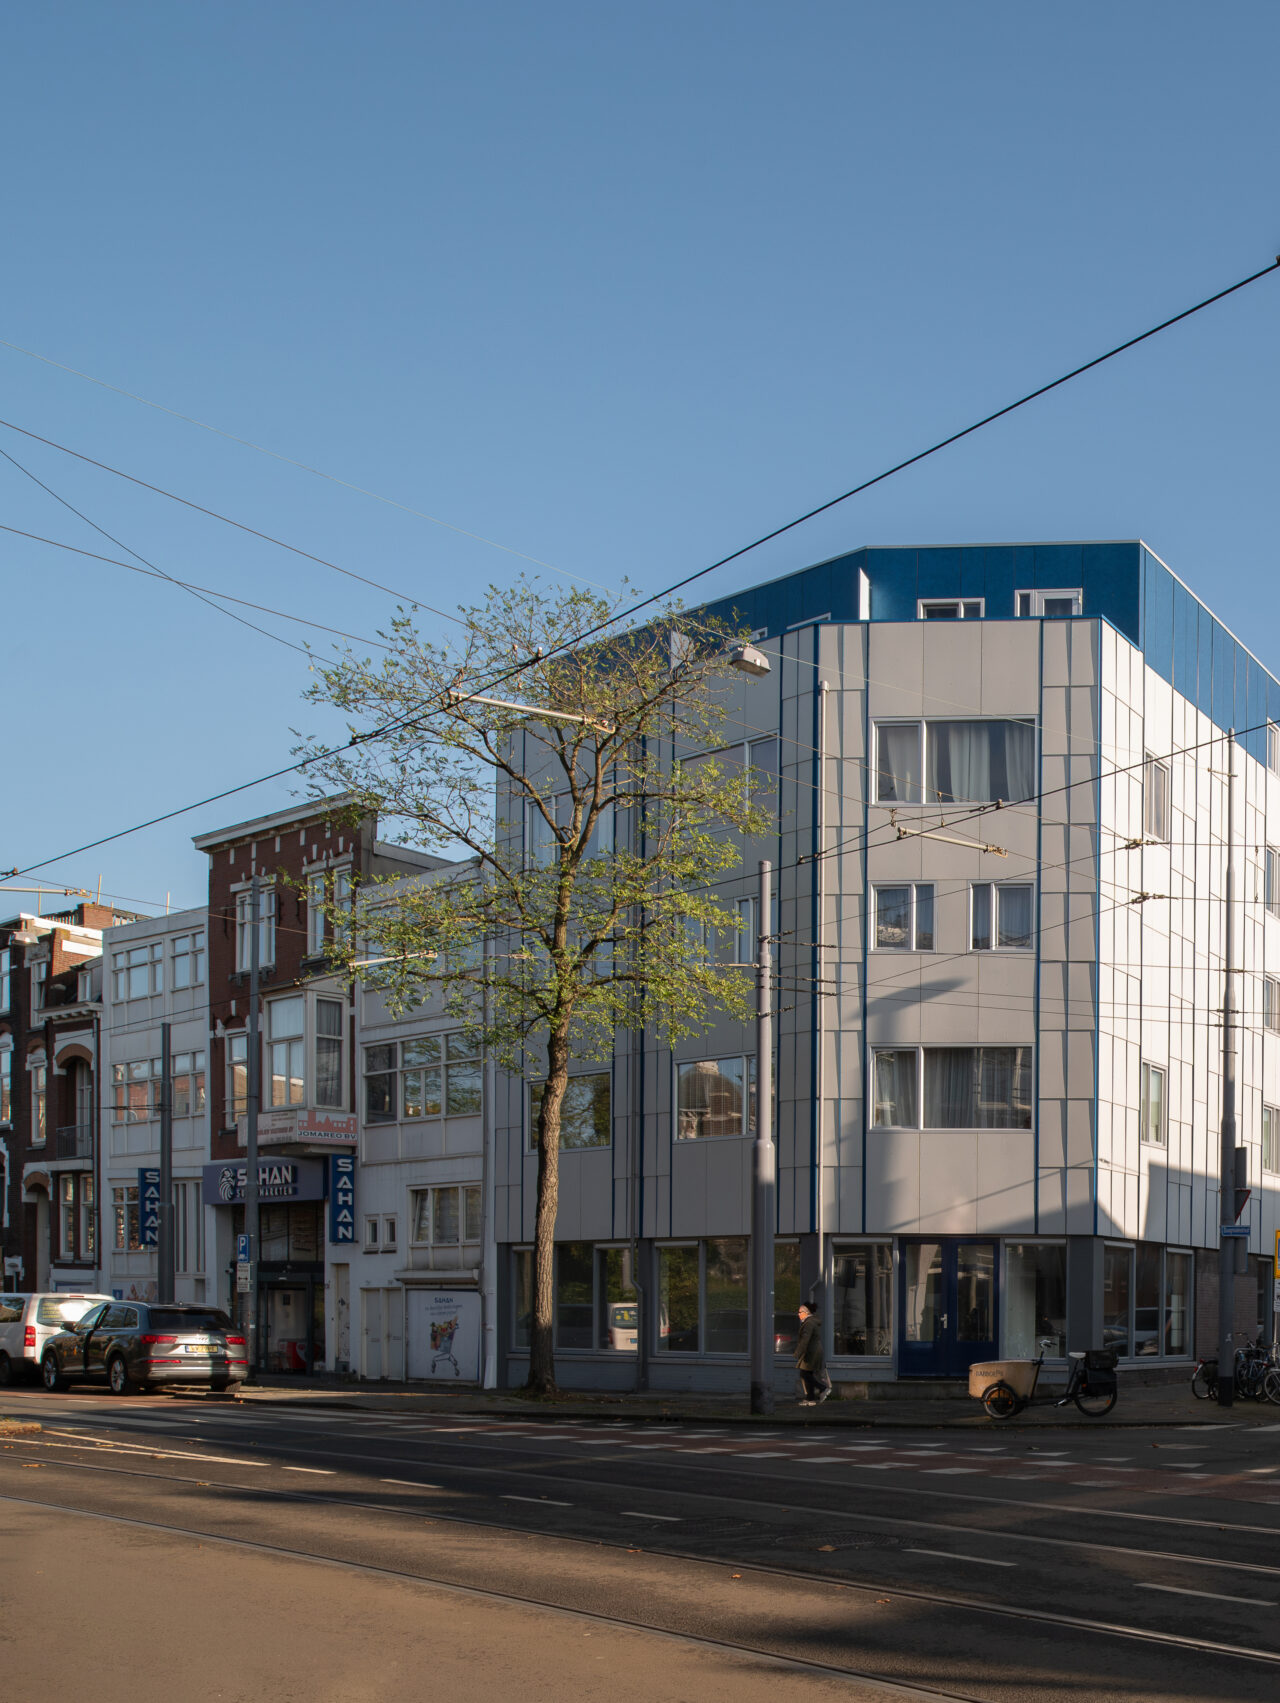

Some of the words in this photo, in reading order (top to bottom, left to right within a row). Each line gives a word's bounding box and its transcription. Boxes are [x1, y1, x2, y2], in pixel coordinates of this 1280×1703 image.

[297, 1130, 343, 1139] JOMAREO
[236, 1164, 293, 1186] SHAN
[144, 1171, 160, 1242] SAHAN
[335, 1158, 353, 1240] SAHAN
